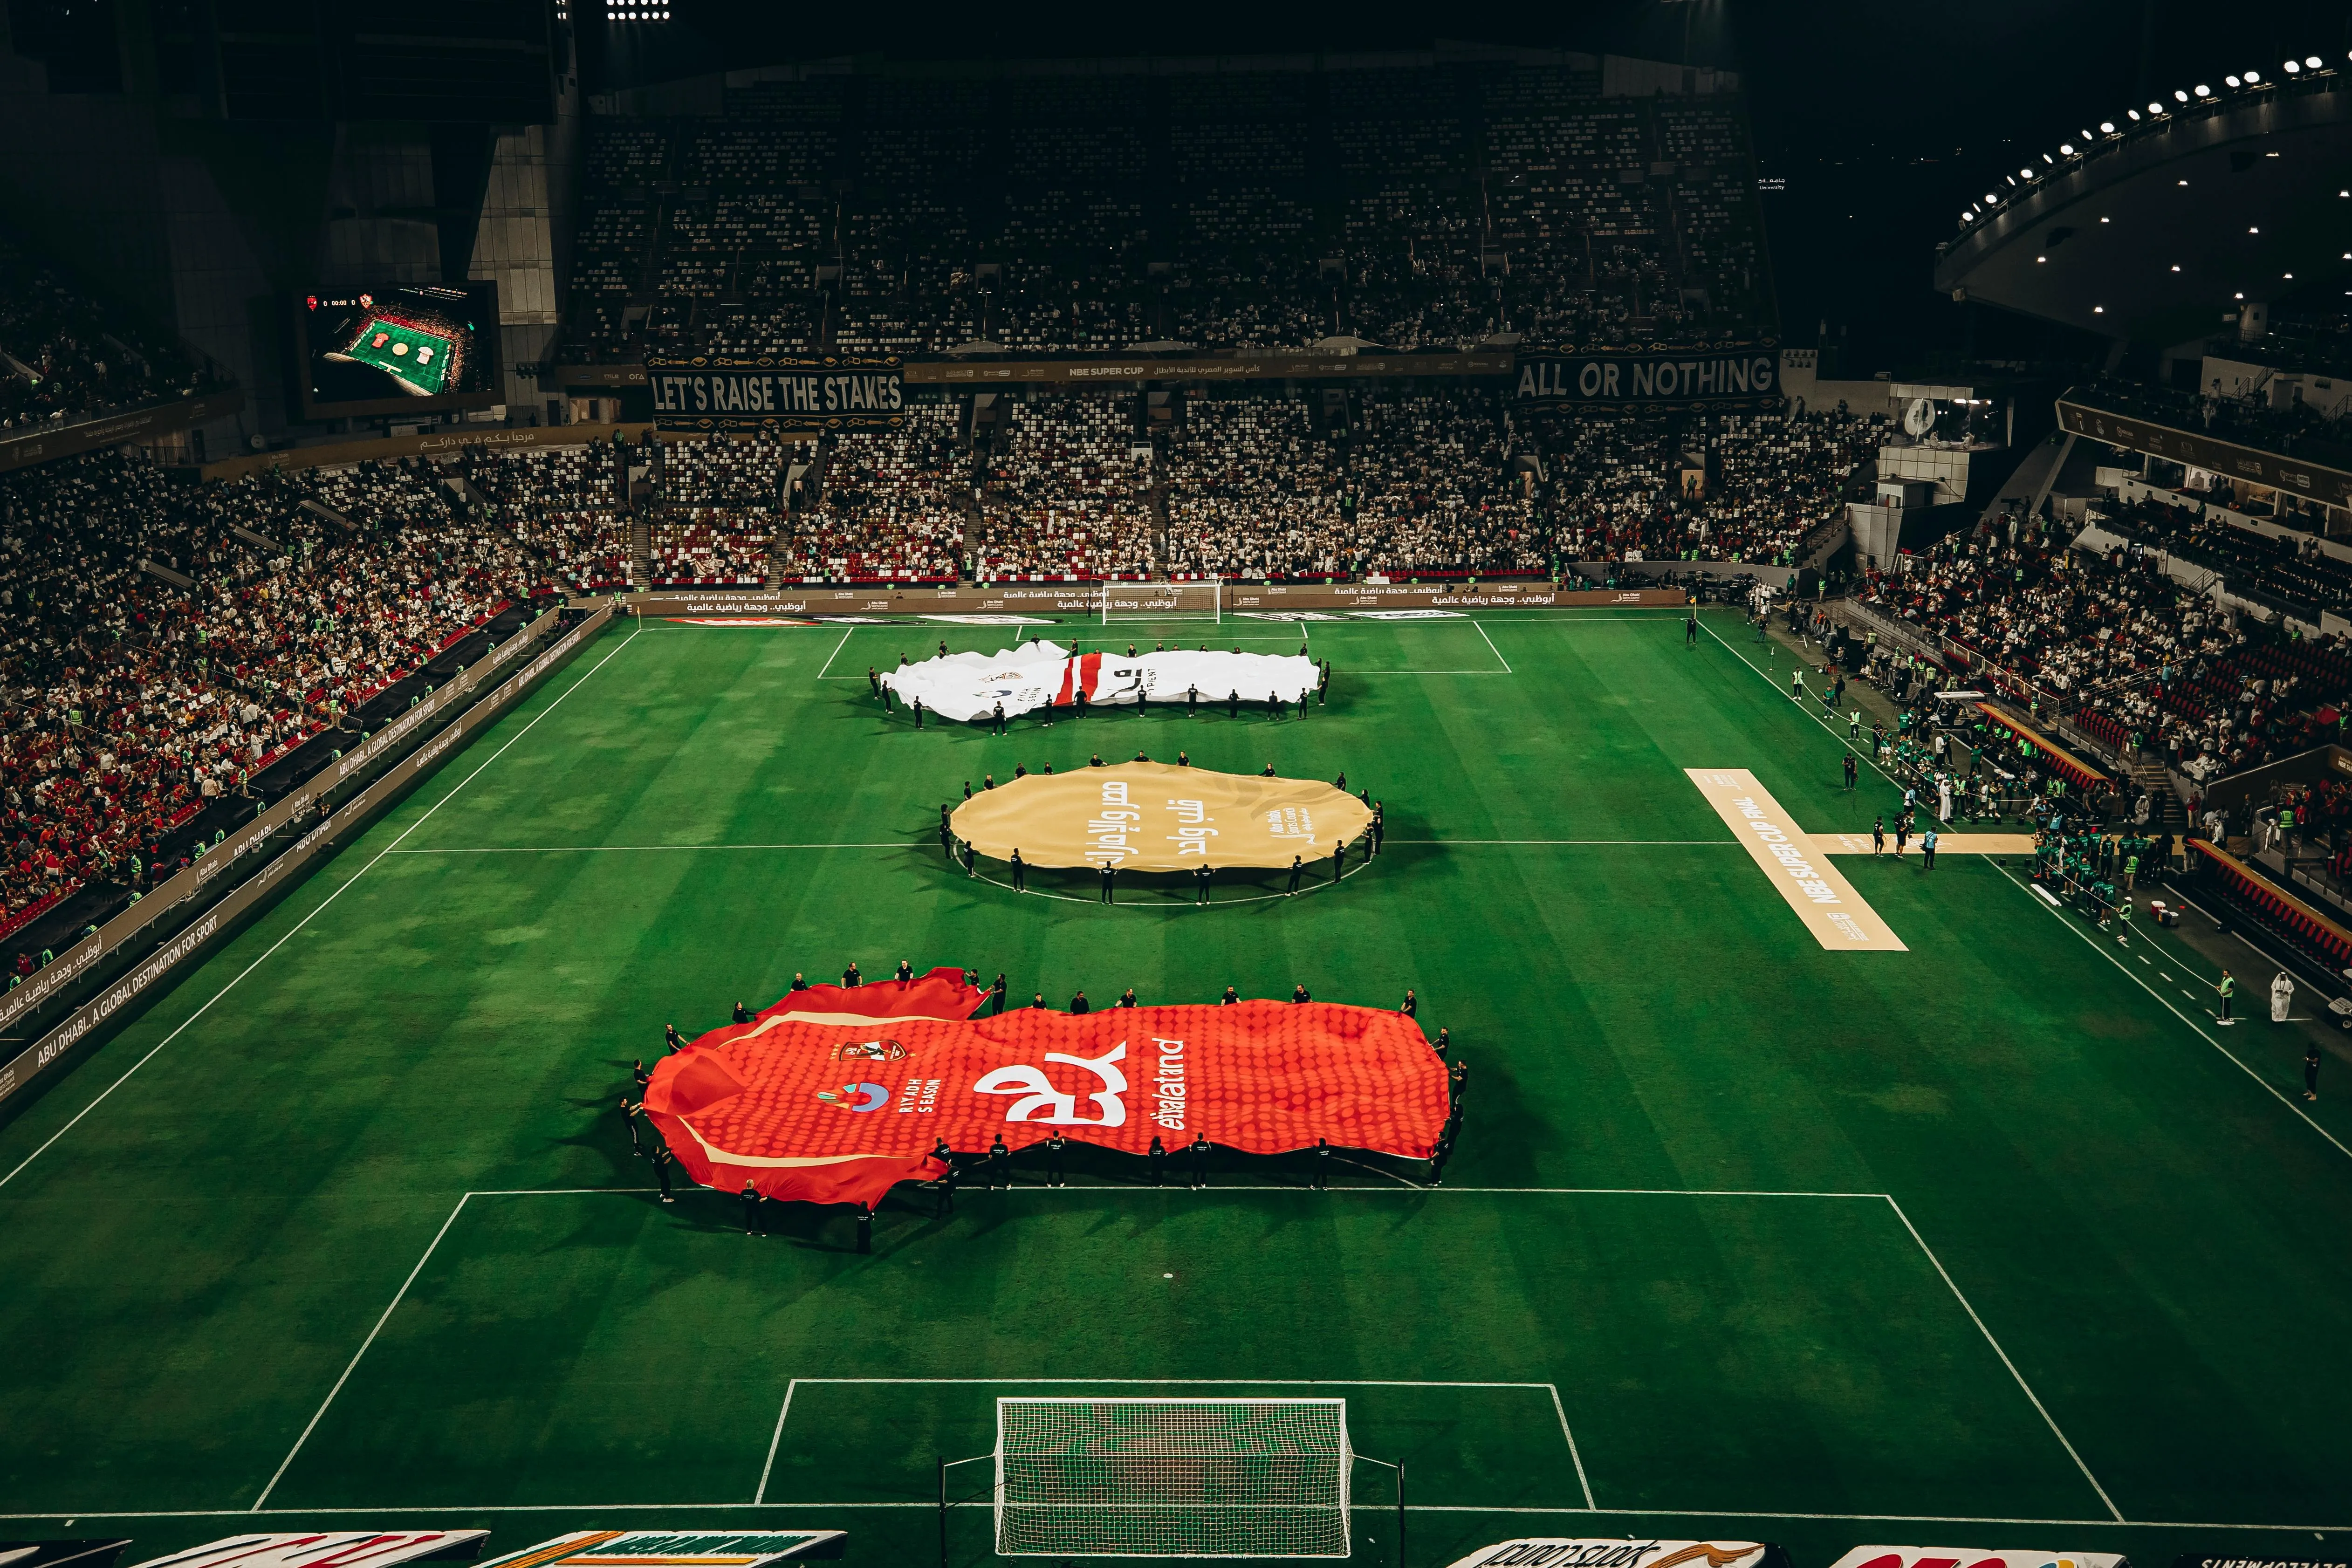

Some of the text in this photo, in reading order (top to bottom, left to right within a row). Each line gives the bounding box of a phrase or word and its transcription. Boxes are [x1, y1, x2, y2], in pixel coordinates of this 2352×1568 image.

[1223, 365, 1244, 374] السوبر
[1517, 357, 1772, 398] ALL OR NOTHING
[651, 375, 902, 411] LET'S RAISE THE STAKES
[687, 603, 714, 612] عالمية
[716, 603, 742, 612] رياضية
[744, 603, 768, 612] وجهة
[1057, 600, 1084, 609] عالمية
[1432, 596, 1460, 605] عالمية
[1461, 596, 1488, 605] رياضية
[1491, 596, 1515, 605] وجهة
[339, 699, 436, 777] ABU DHABI.. A GLOBAL DESTINATION FOR SPORT
[1102, 781, 1140, 809] مصر
[1166, 799, 1219, 855] قلب واحد
[1266, 809, 1284, 834] Abu Dhabi
[1287, 822, 1302, 834] Sports
[1732, 797, 1842, 904] NBE SUPER CUP FINAL
[207, 858, 218, 871] Dhabi
[50, 964, 71, 984] وجهة
[25, 979, 50, 1002] رياضية
[38, 914, 217, 1068] ABU DHABI.. A GLOBAL DESTINATION FOR SPORT
[4, 1068, 14, 1081] Dhabi
[898, 1078, 923, 1114] RIYADH
[917, 1079, 941, 1113] SEASON
